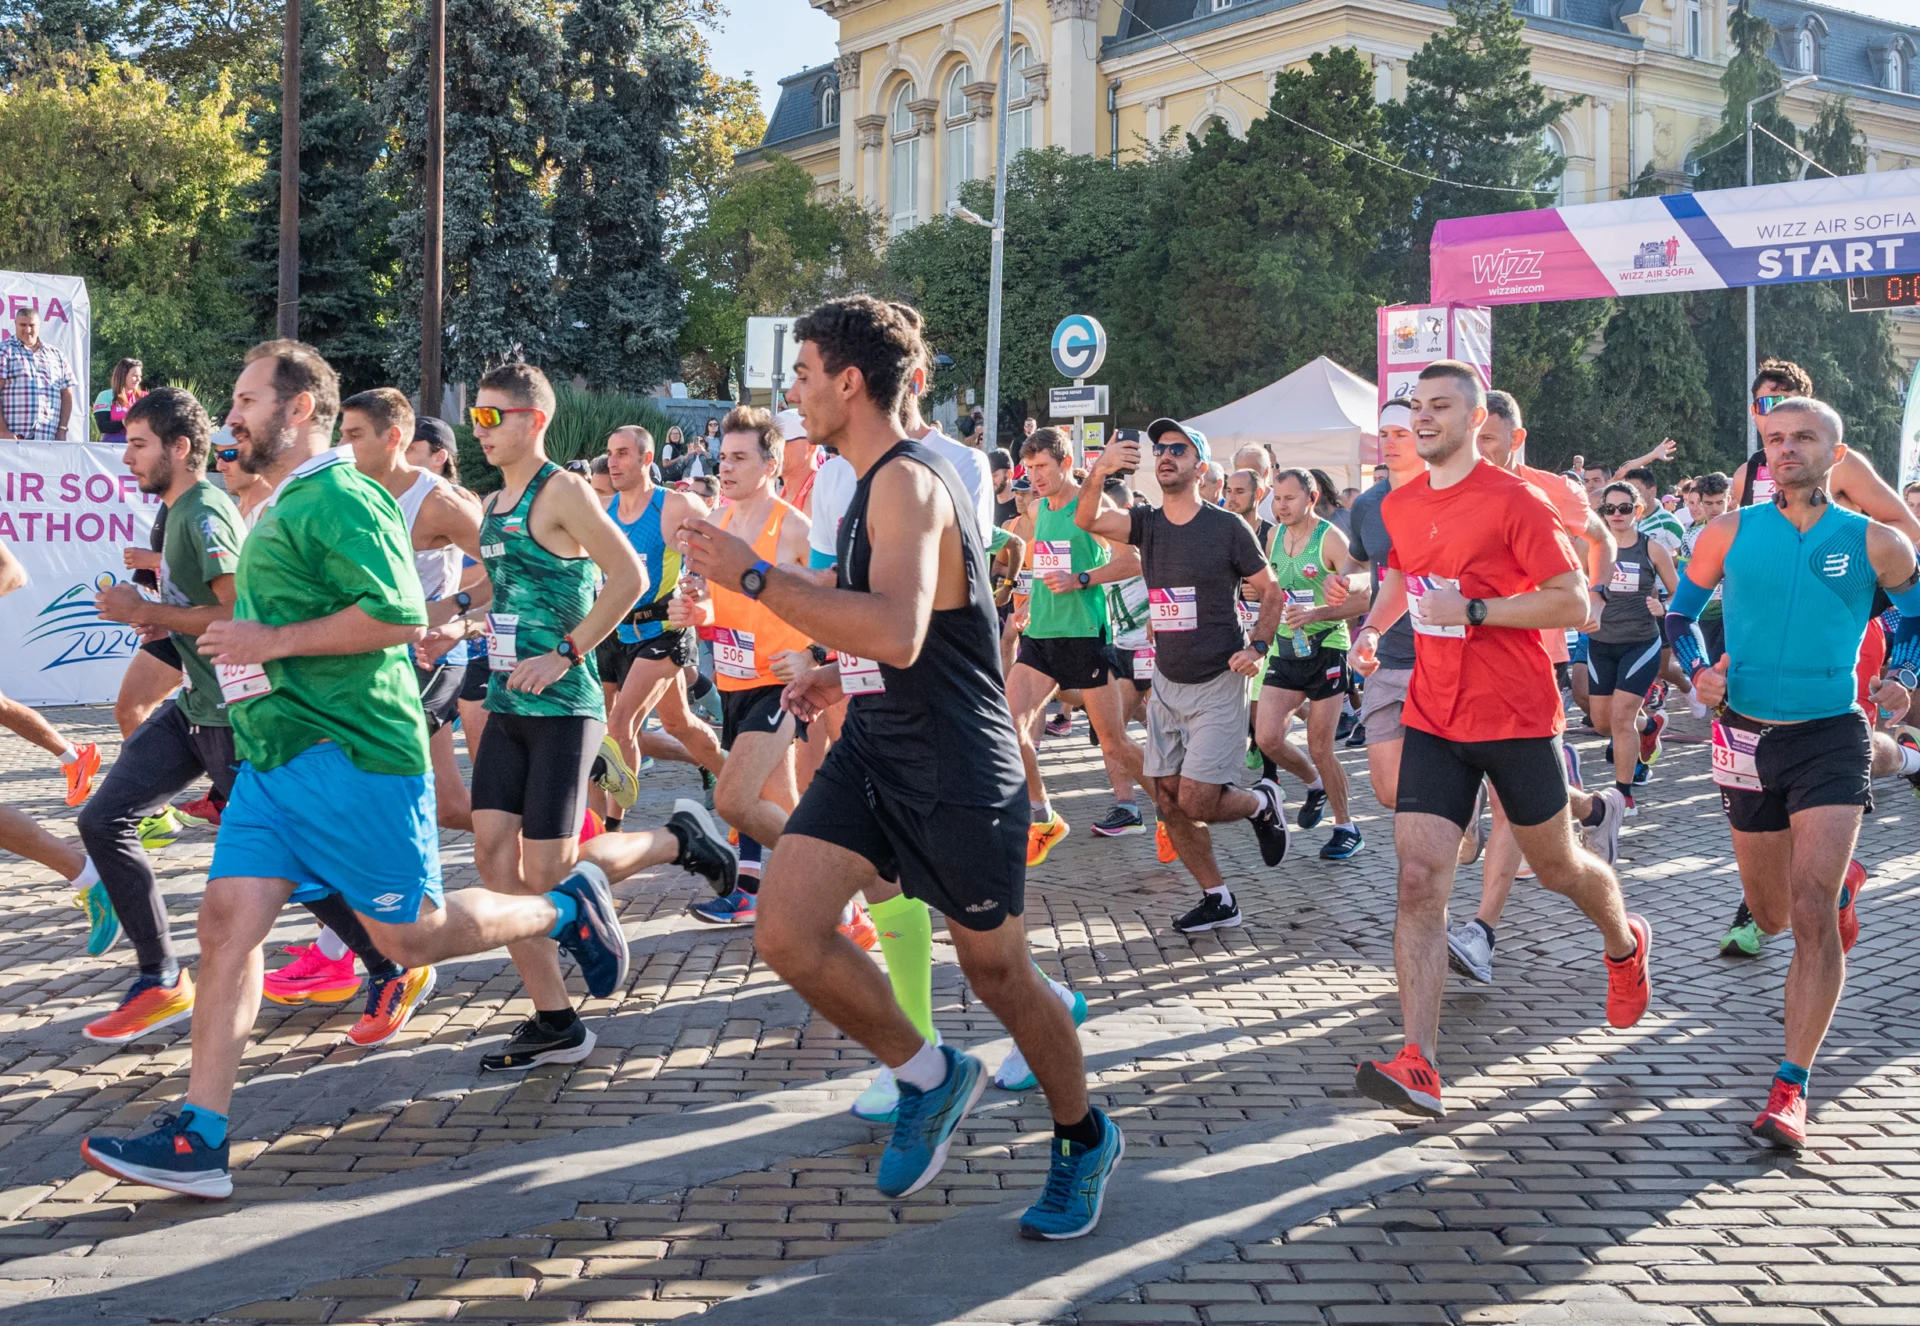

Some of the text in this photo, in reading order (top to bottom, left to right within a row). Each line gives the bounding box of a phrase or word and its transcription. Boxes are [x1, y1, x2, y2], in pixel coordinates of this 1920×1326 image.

[1757, 212, 1916, 239] WIZZ AIR SOFIA
[1757, 238, 1904, 279] START
[1619, 267, 1694, 280] WIZZ AIR SOFIA
[1488, 284, 1544, 296] wizzair.com
[0, 472, 162, 504] IR SOF
[1040, 555, 1059, 566] 308
[1160, 604, 1179, 617] 519
[39, 630, 140, 672] 2024
[723, 646, 744, 663] 506
[1712, 747, 1735, 769] 431
